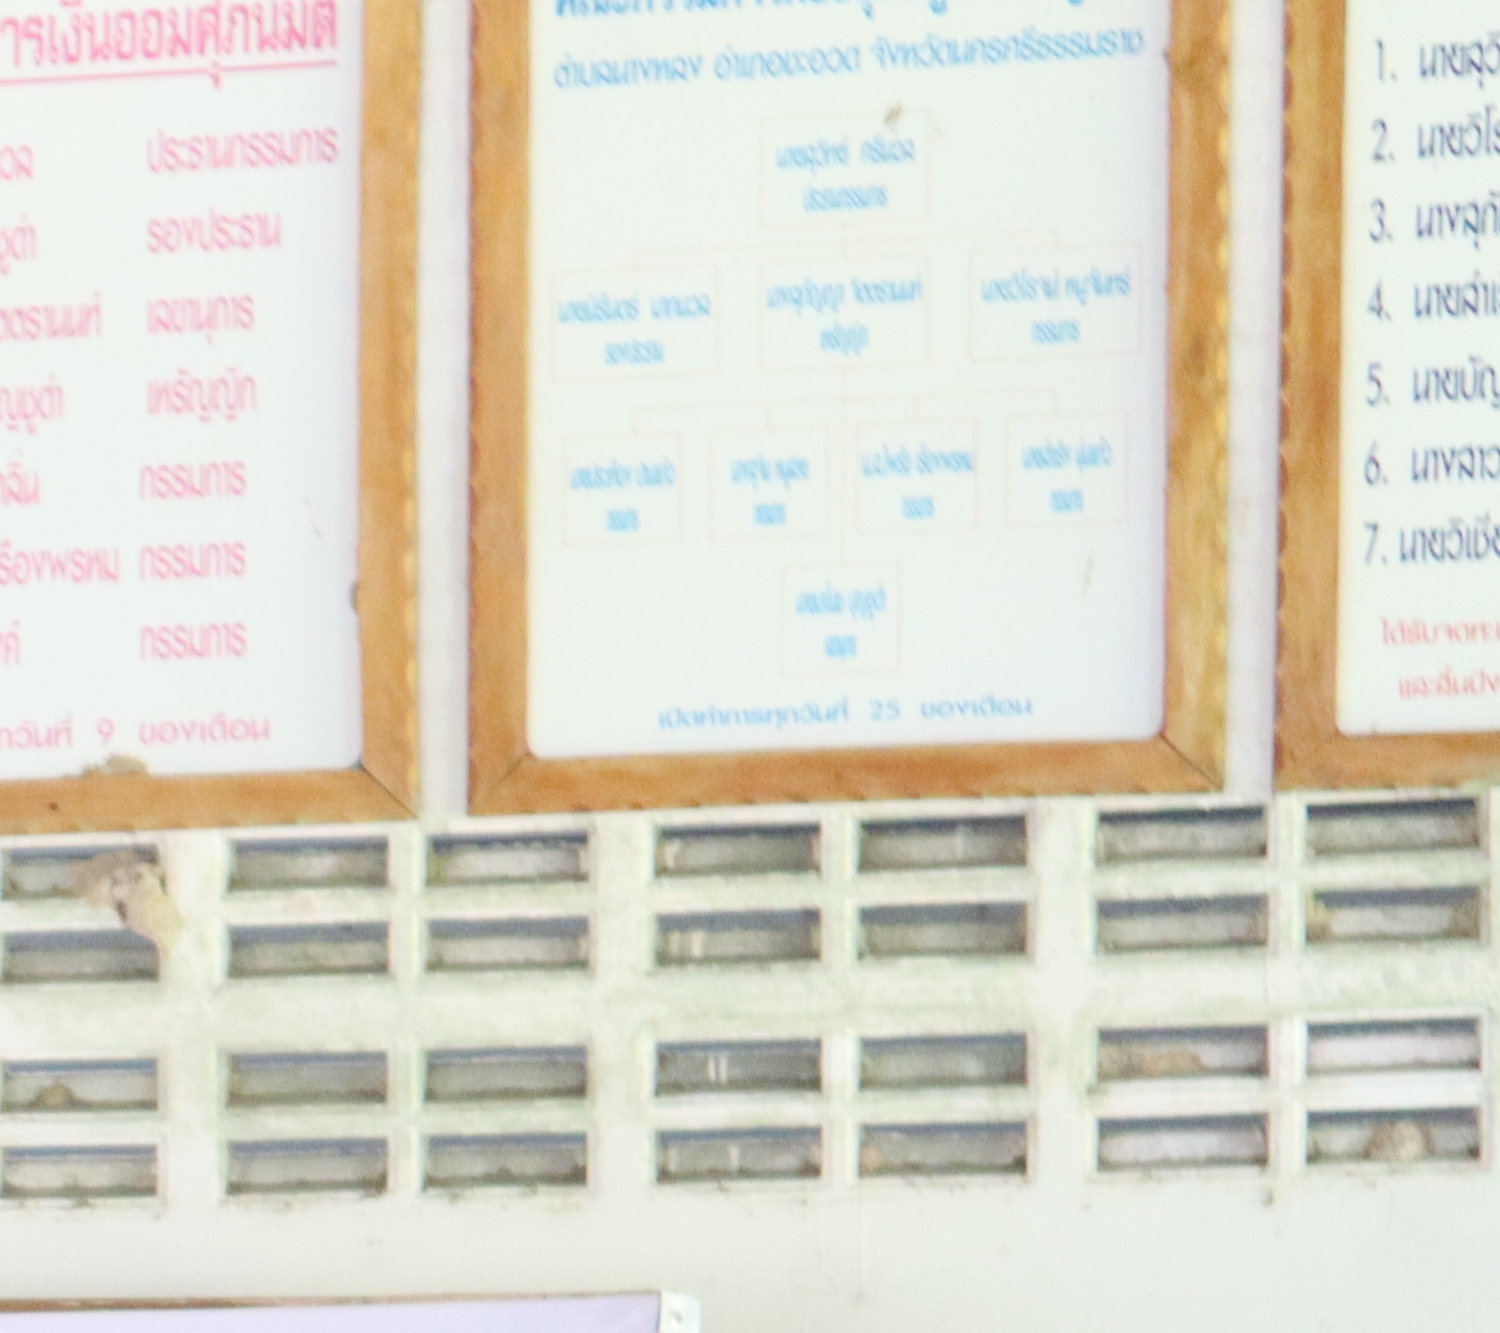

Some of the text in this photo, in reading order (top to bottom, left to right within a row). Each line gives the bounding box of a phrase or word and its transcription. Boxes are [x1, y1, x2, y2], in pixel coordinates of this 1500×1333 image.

[1375, 38, 1397, 82] 1.
[1370, 117, 1394, 163] 2.
[1368, 197, 1393, 244] 3.
[1366, 280, 1391, 321] 4.
[1365, 362, 1390, 408] 5.
[139, 460, 247, 499] กรรมการ
[1363, 441, 1388, 487] 6.
[139, 541, 246, 580] กรรมการ
[1363, 521, 1387, 565] 7.
[139, 621, 247, 660] กรรมการ
[96, 717, 114, 744] 9
